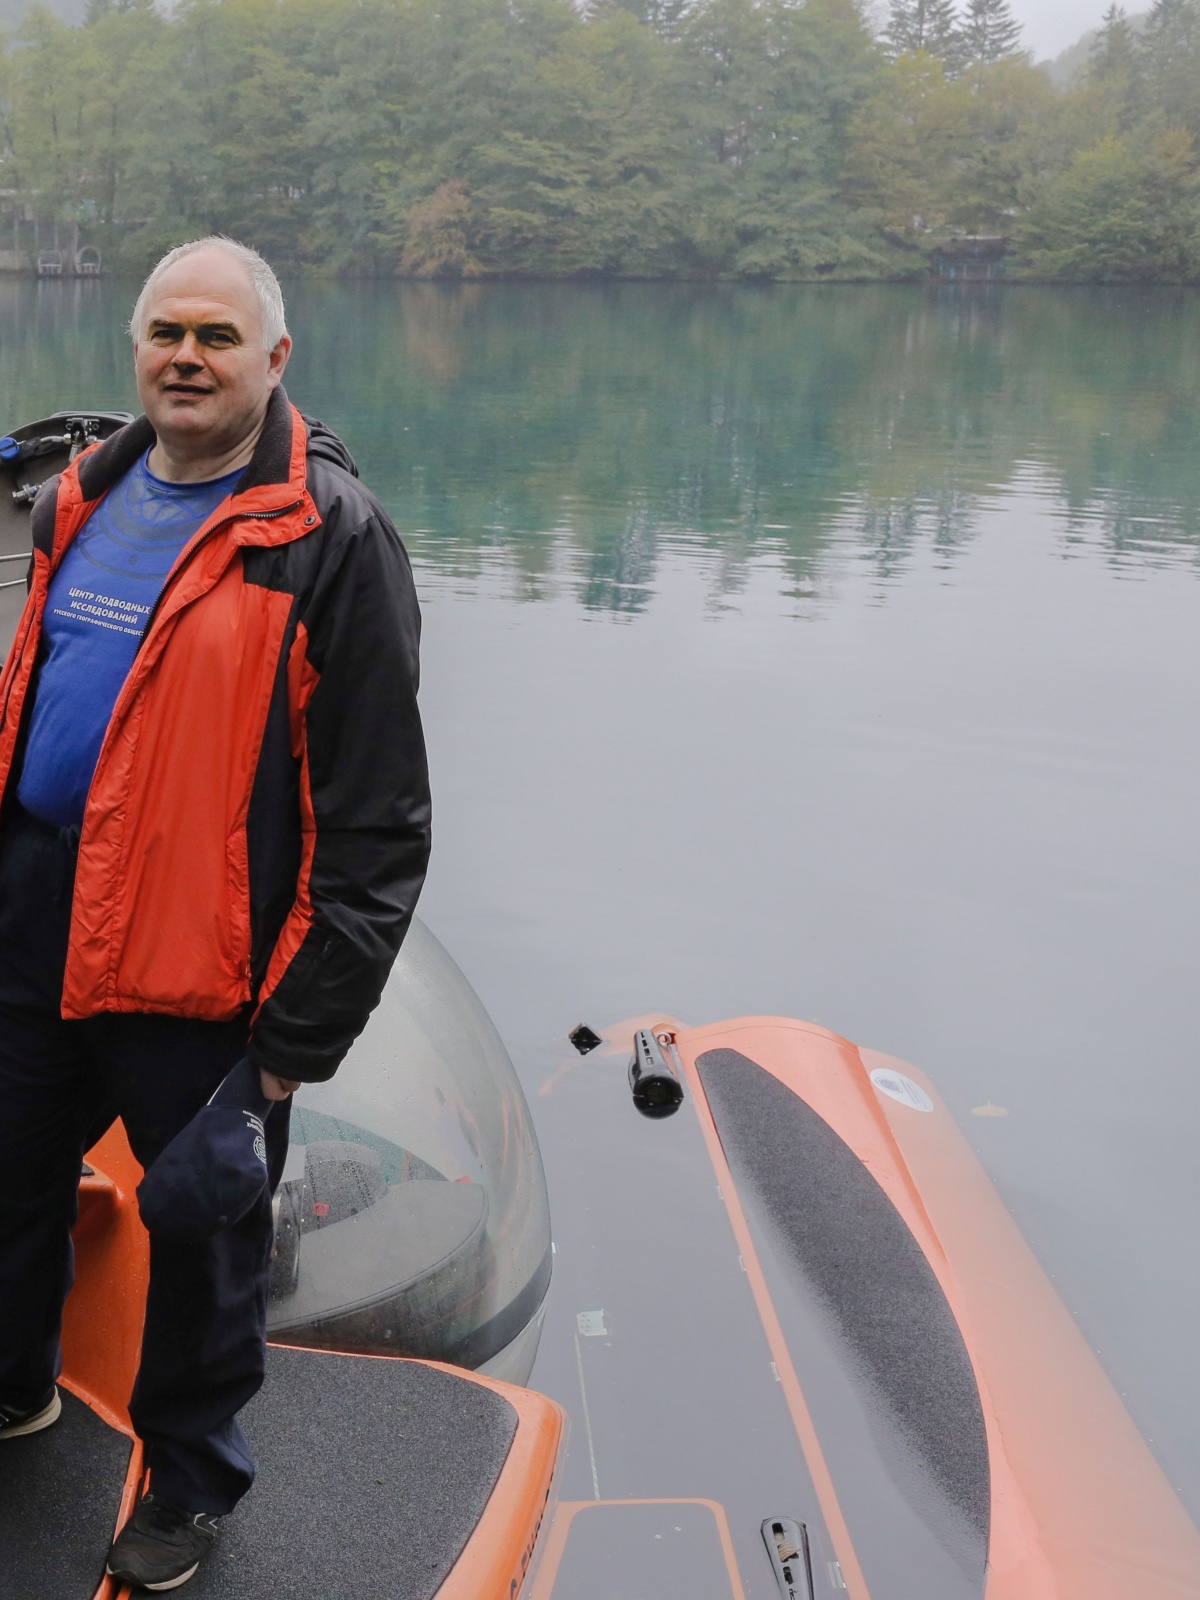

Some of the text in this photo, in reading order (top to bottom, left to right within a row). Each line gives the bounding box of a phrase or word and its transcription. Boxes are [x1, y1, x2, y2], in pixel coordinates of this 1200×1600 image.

[68, 587, 151, 615] ЦЕНТР ПОДВОДНЫХ
[70, 600, 139, 625] ИССЛЕДОВАНИЙ
[53, 608, 76, 619] РУССКОГО
[76, 614, 123, 632] ГЕОГРАФИЧЕСКОГО
